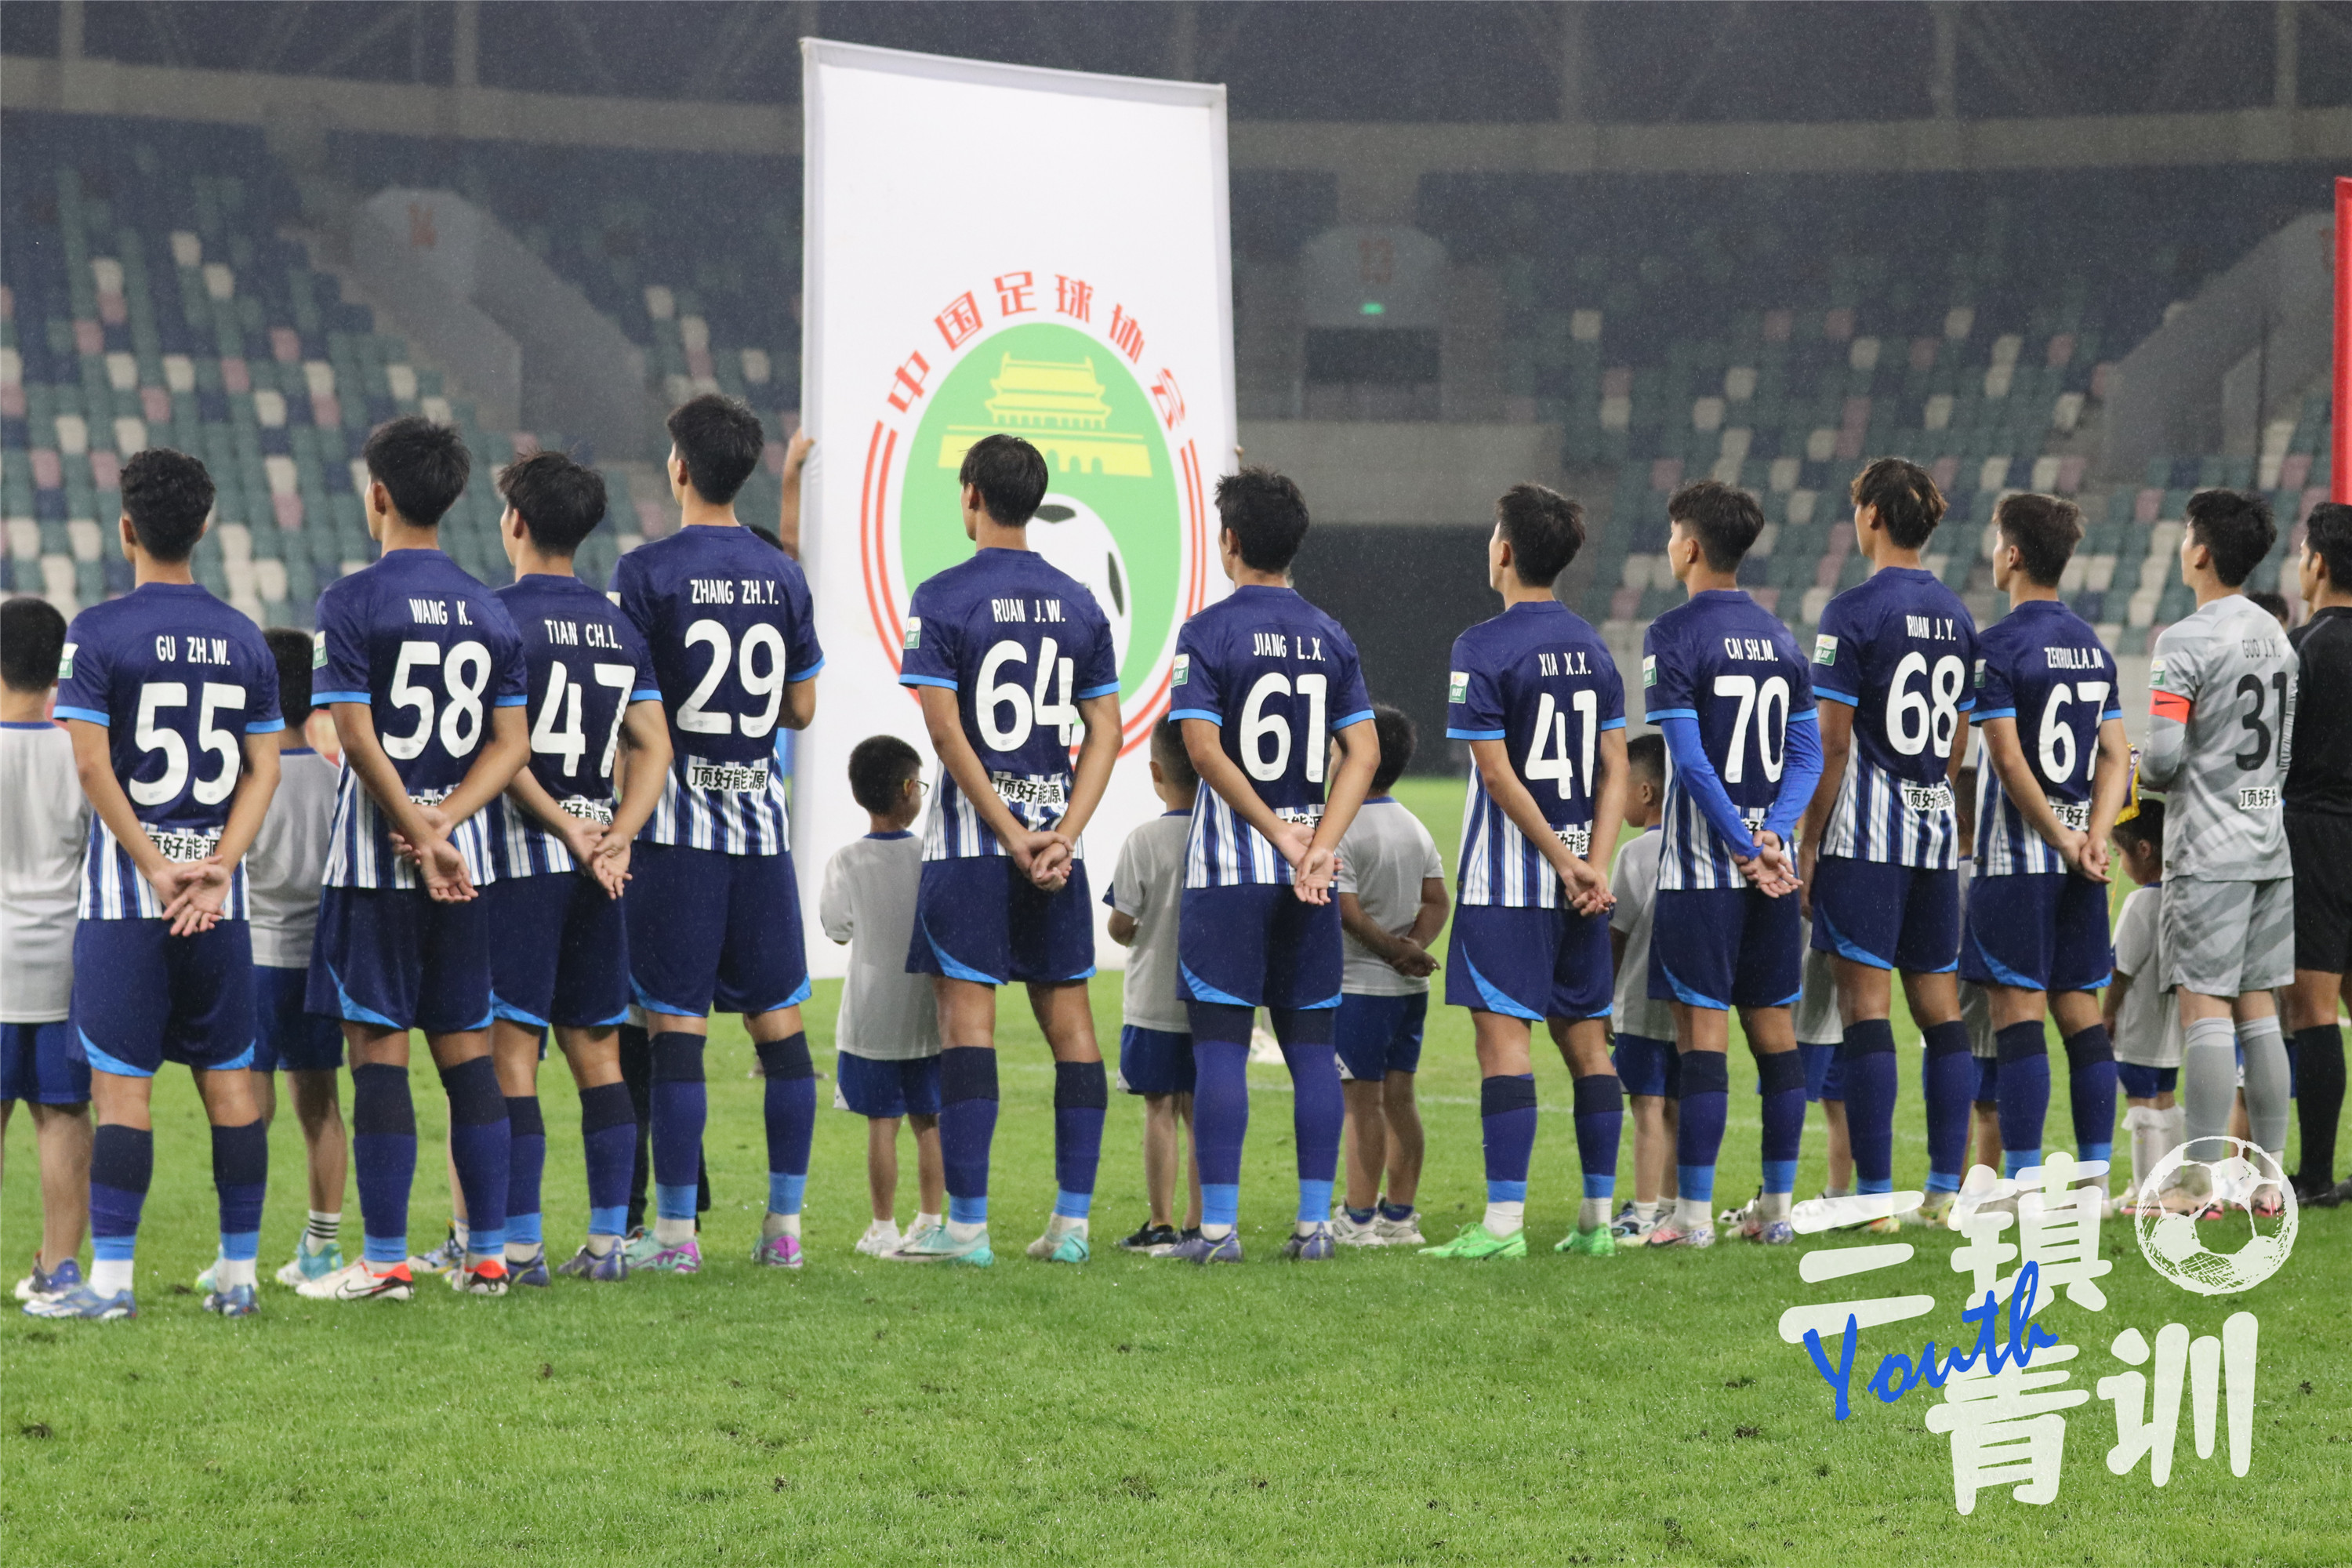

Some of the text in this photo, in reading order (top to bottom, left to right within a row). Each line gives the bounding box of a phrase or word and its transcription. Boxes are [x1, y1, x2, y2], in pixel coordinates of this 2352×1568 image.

[887, 270, 1185, 432] 中国足球协会
[408, 598, 474, 626] WANG K.
[544, 619, 622, 650] TIAN CH.L.
[690, 579, 779, 605] ZHANG ZH.Y.
[991, 598, 1066, 623] RUAN J.W.
[1906, 615, 1957, 641] RUAN J.Y.
[156, 635, 231, 666] GU ZH.W.
[676, 619, 786, 739] 29
[975, 637, 1076, 753] 64
[1253, 633, 1326, 662] JIANG L.X.
[1538, 652, 1592, 677] XIA X.X.
[1724, 637, 1779, 662] CAI SH.M.
[129, 681, 246, 807] 55
[382, 641, 492, 760] 58
[530, 660, 637, 779] 47
[1239, 672, 1327, 782] 61
[1524, 689, 1598, 800] 41
[1713, 675, 1790, 783] 70
[1886, 651, 1965, 758] 68
[2038, 681, 2111, 784] 67
[2235, 671, 2288, 771] 31
[691, 765, 768, 792] 顶好能源
[996, 777, 1062, 804] 顶好能源
